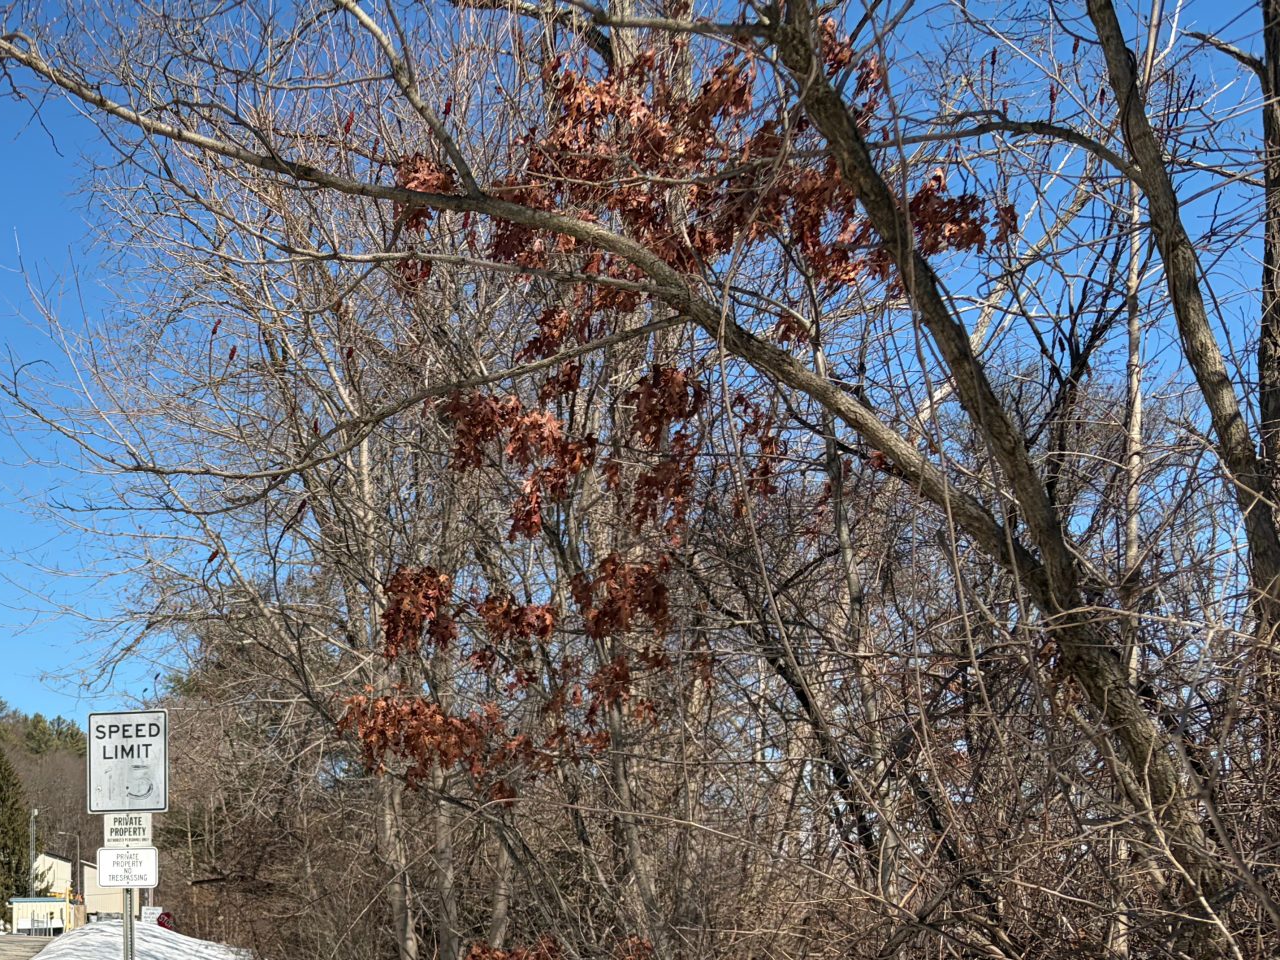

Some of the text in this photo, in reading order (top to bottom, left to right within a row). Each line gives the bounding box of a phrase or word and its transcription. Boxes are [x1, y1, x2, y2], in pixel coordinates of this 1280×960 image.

[95, 723, 161, 740] SPEED
[103, 744, 153, 760] LIMIT
[113, 816, 143, 827] PRIVATE
[110, 827, 147, 837] PROPERTY
[116, 853, 140, 861] PRIVATE
[112, 860, 143, 868] PROPERTY
[123, 867, 132, 875] NO
[108, 874, 148, 882] TRESPASSING
